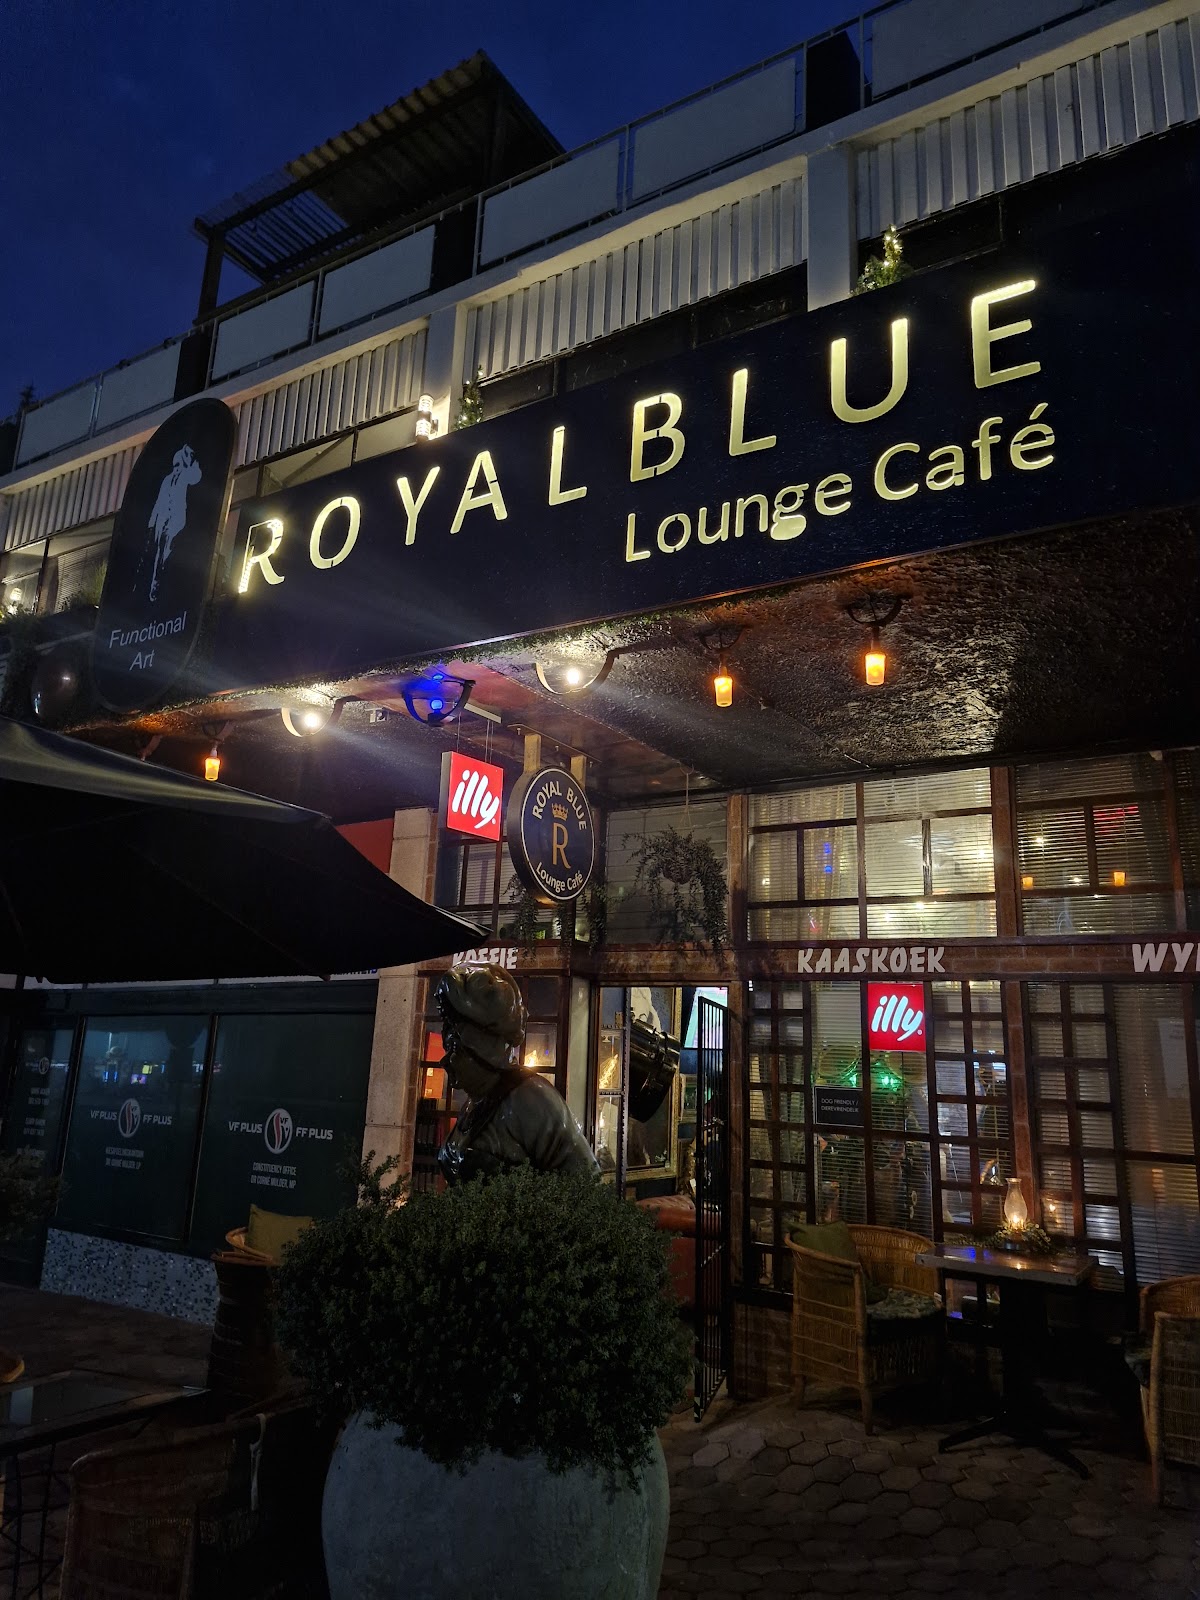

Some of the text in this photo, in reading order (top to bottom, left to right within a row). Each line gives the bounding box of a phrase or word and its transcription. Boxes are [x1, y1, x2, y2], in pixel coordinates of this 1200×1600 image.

[238, 279, 1042, 594] ROYAL BLUE
[625, 403, 1056, 563] Lounge Café
[109, 611, 187, 649] Functional
[129, 649, 155, 671] Art
[451, 769, 500, 829] illy
[532, 780, 587, 831] ROYAL BLUE
[552, 822, 572, 869] R
[536, 862, 584, 893] Lounge Café
[797, 946, 946, 974] KAASKOEK
[871, 994, 924, 1042] illy
[100, 1111, 118, 1121] PLUS
[153, 1115, 173, 1126] PLUS
[228, 1121, 263, 1134] VF PLUS
[296, 1127, 334, 1140] FF PLUS
